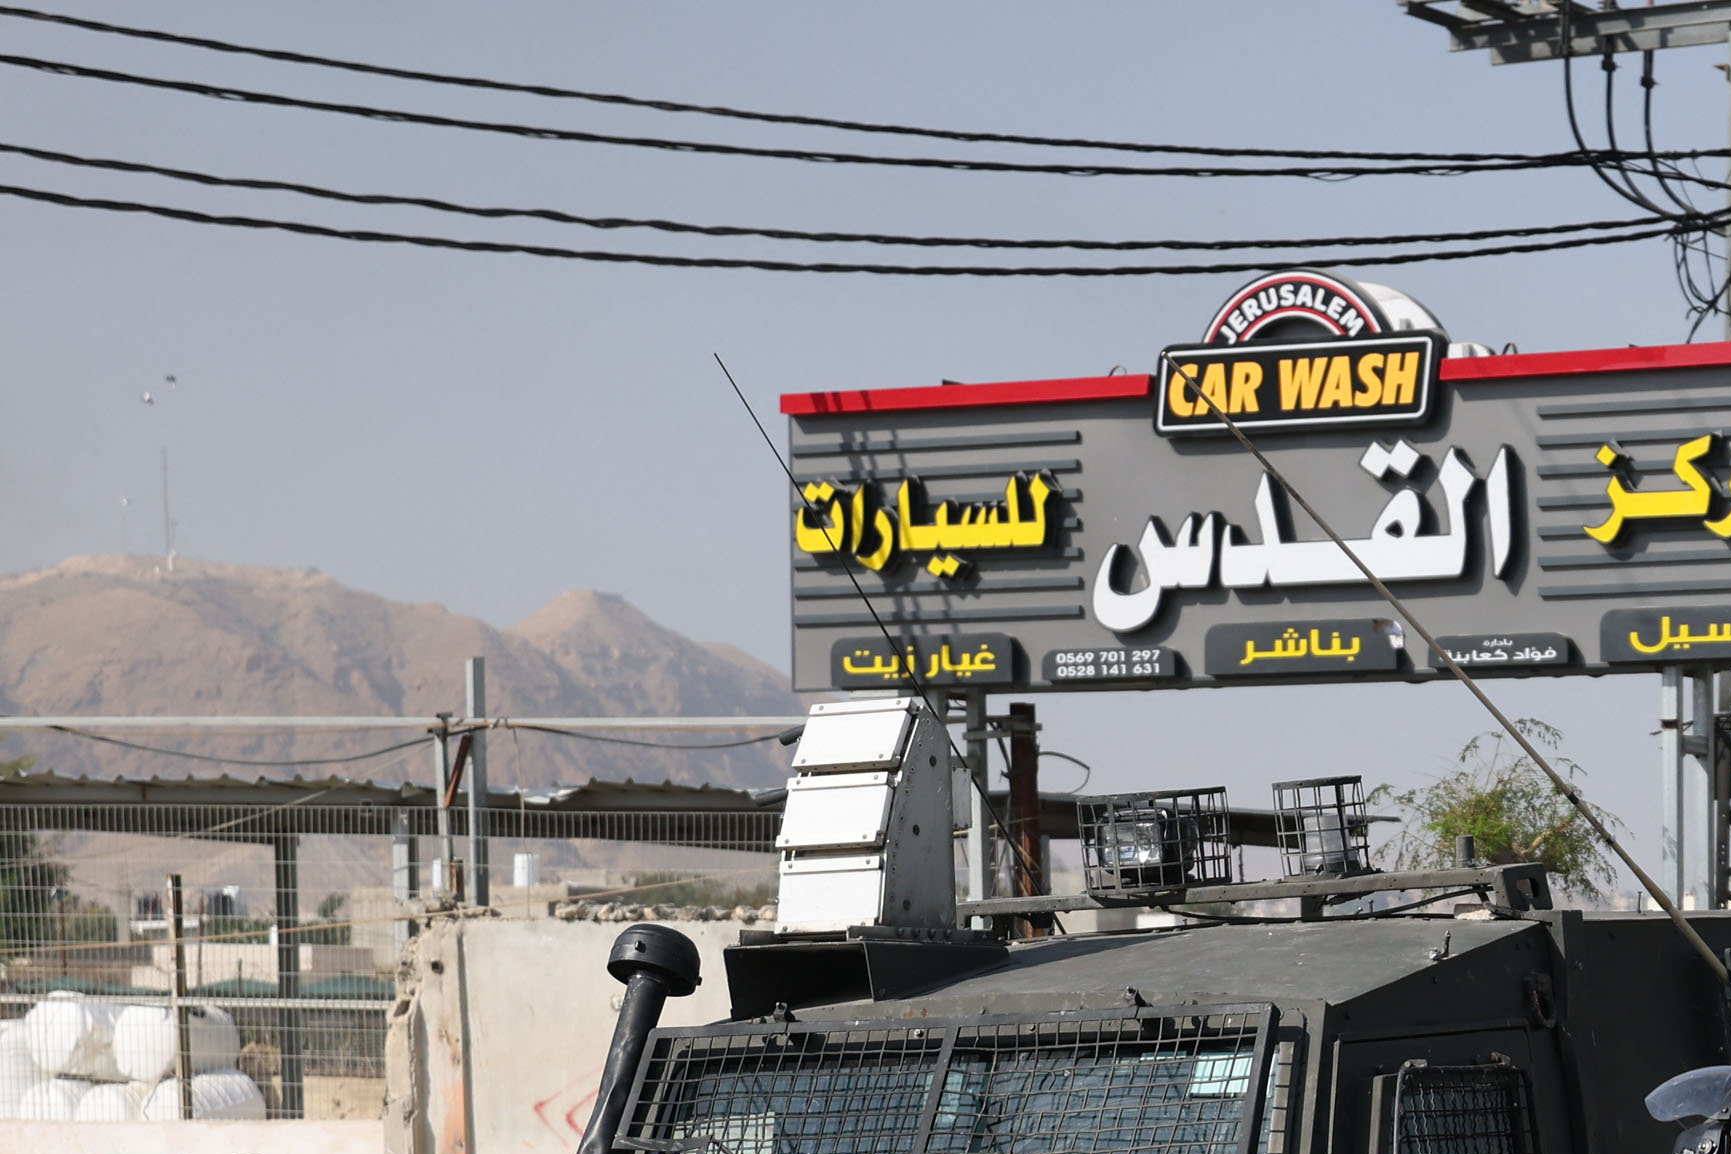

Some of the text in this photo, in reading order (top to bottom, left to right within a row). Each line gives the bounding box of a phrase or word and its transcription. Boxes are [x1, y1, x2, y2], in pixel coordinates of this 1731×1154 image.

[1220, 284, 1365, 345] JERUSALEM
[1169, 352, 1420, 417] CAR WASH
[795, 472, 1050, 578] للسيارات
[1093, 437, 1511, 633] القدس
[842, 643, 997, 680] غيار زيت
[1056, 649, 1161, 664] 0569 701 297
[1239, 627, 1361, 666] بناشر
[1513, 645, 1558, 662] فؤاد
[1057, 662, 1160, 677] 0528 141 631
